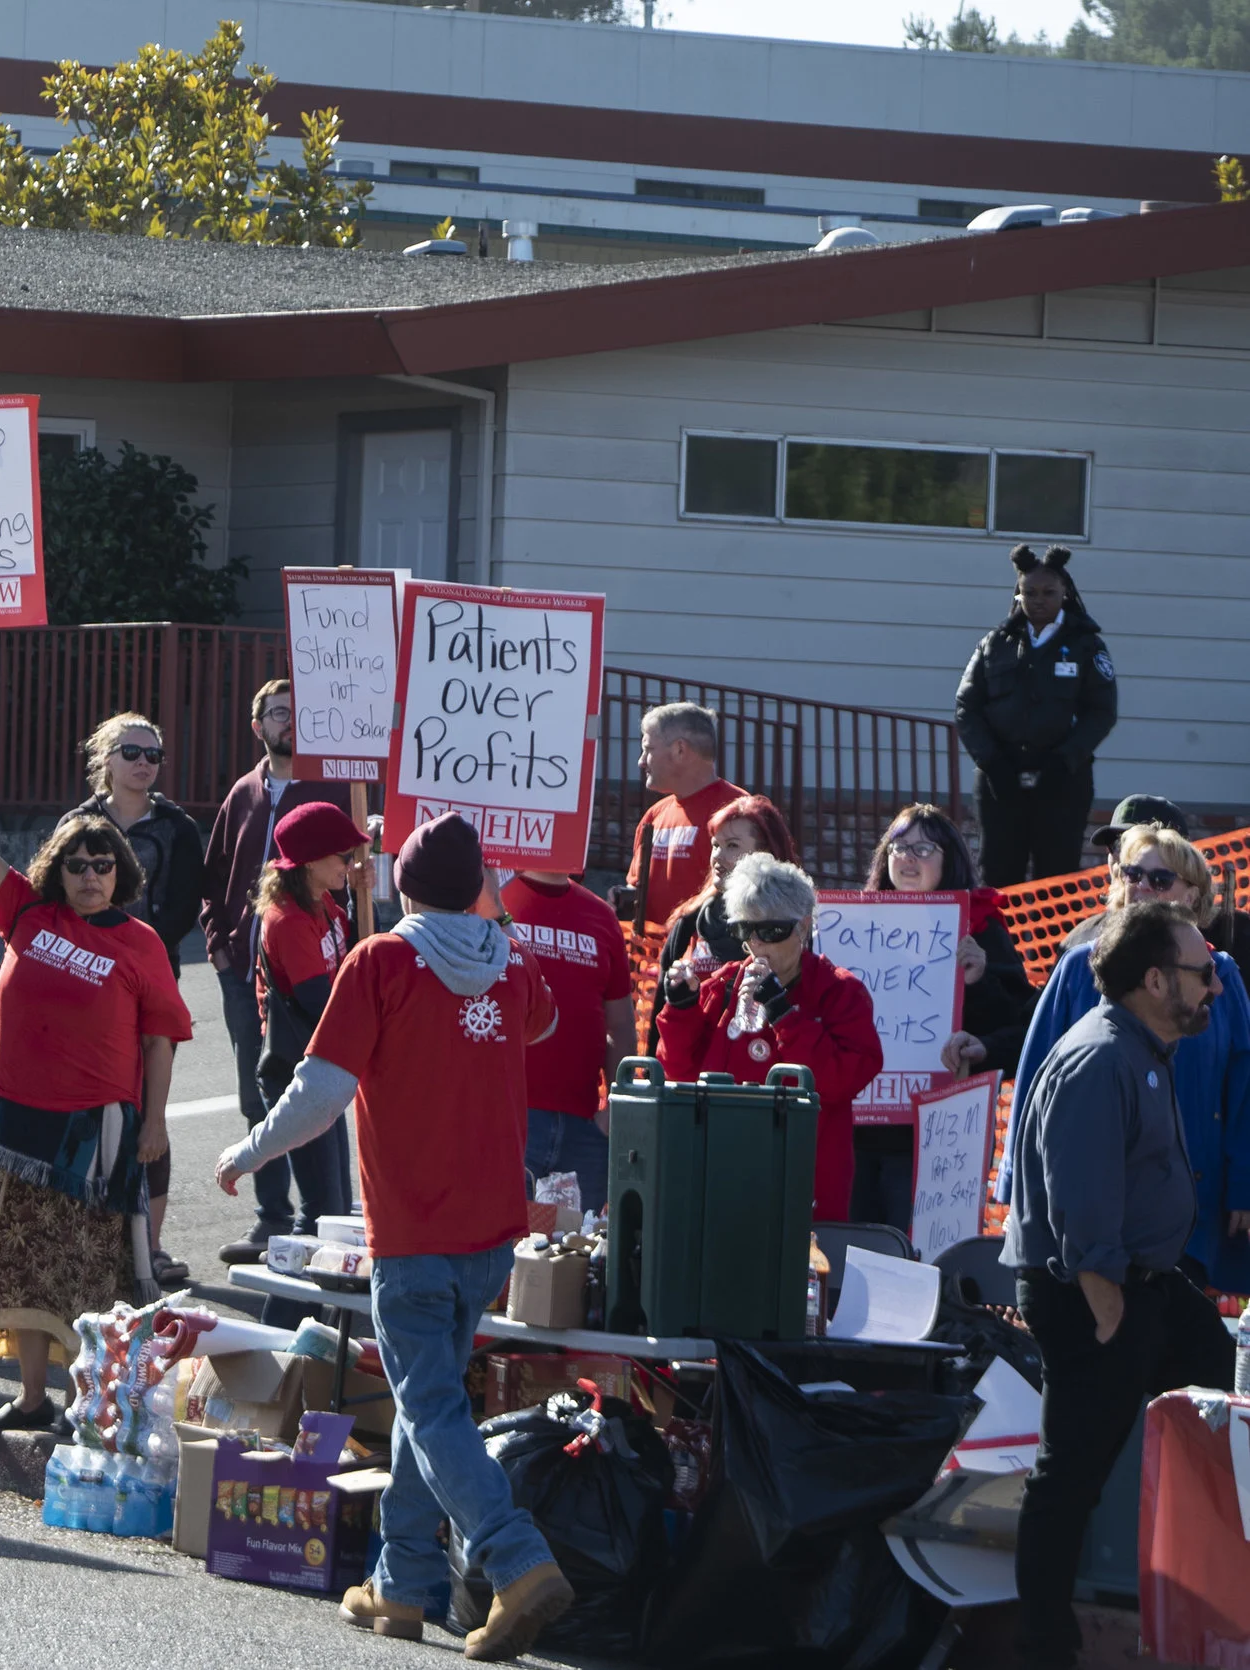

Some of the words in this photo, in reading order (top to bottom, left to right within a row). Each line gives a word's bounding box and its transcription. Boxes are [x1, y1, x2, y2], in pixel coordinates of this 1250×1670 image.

[301, 588, 369, 629] Fund
[423, 583, 464, 597] NATIONAL
[464, 589, 491, 600] UNION
[502, 593, 551, 605] HEALTHCARE
[552, 597, 587, 607] WORKERS
[427, 599, 577, 675] Patients
[295, 636, 387, 694] Staffing
[329, 675, 360, 702] not
[298, 706, 344, 743] CEO
[324, 760, 377, 777] NUHW
[414, 715, 569, 789] Profits
[32, 930, 114, 974] NUHW
[514, 925, 596, 953] NUHW
[817, 910, 953, 963] Patients
[22, 948, 66, 971] HEALTHCARE
[69, 967, 103, 987] WORKERS
[31, 946, 64, 963] NATIONAL
[65, 960, 89, 975] UNION
[565, 955, 599, 968] WORKERS
[922, 1110, 959, 1149] $43
[128, 1338, 153, 1408] ARROWHEAD
[246, 1535, 262, 1549] Fun
[262, 1537, 286, 1552] Flavor
[288, 1541, 303, 1554] Mix
[309, 1543, 321, 1556] 54
